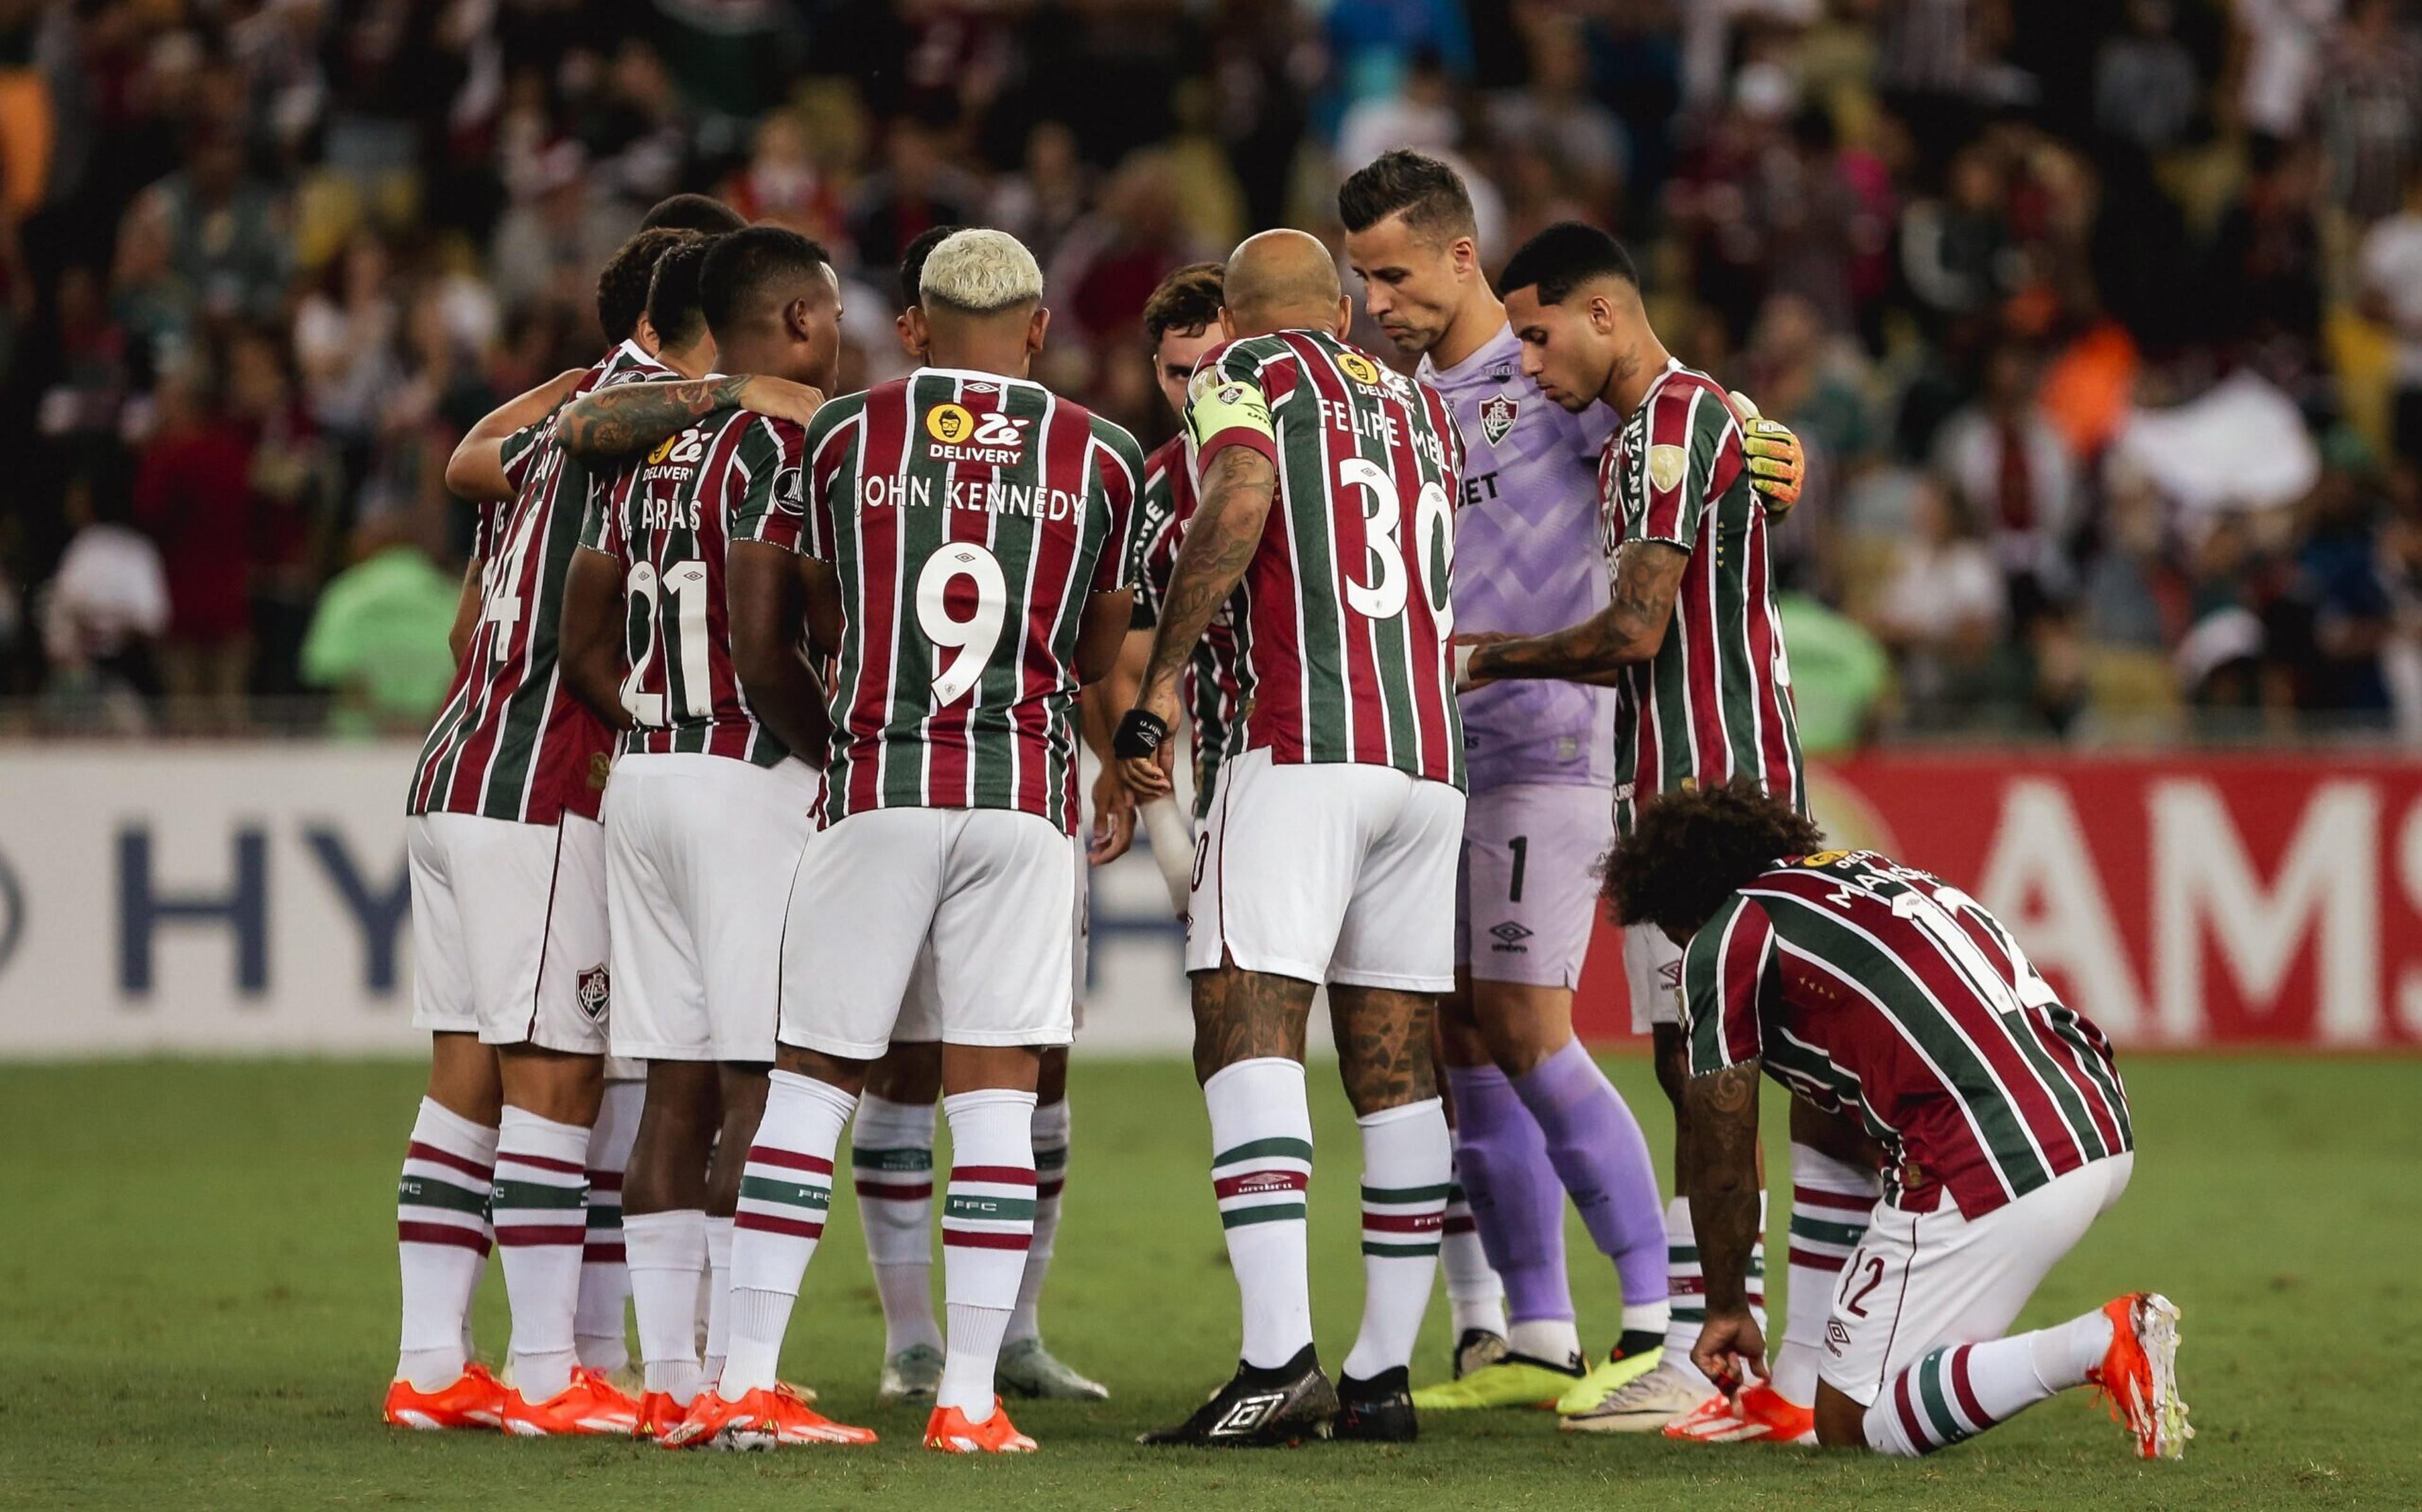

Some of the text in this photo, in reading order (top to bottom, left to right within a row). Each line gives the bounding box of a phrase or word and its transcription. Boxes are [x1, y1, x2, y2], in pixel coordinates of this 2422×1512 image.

[929, 443, 1022, 464] DELIVERY
[1318, 398, 1401, 448] FELIPE
[855, 474, 1087, 526] JOHN KENNEDY
[1338, 458, 1459, 643] 30
[619, 559, 713, 727] 21
[916, 541, 1007, 708] 9
[1507, 835, 1528, 904] 1
[1977, 774, 2422, 1048] AM
[1891, 885, 2065, 1016] 12
[953, 1199, 997, 1213] FFC
[1838, 1247, 1886, 1319] 12
